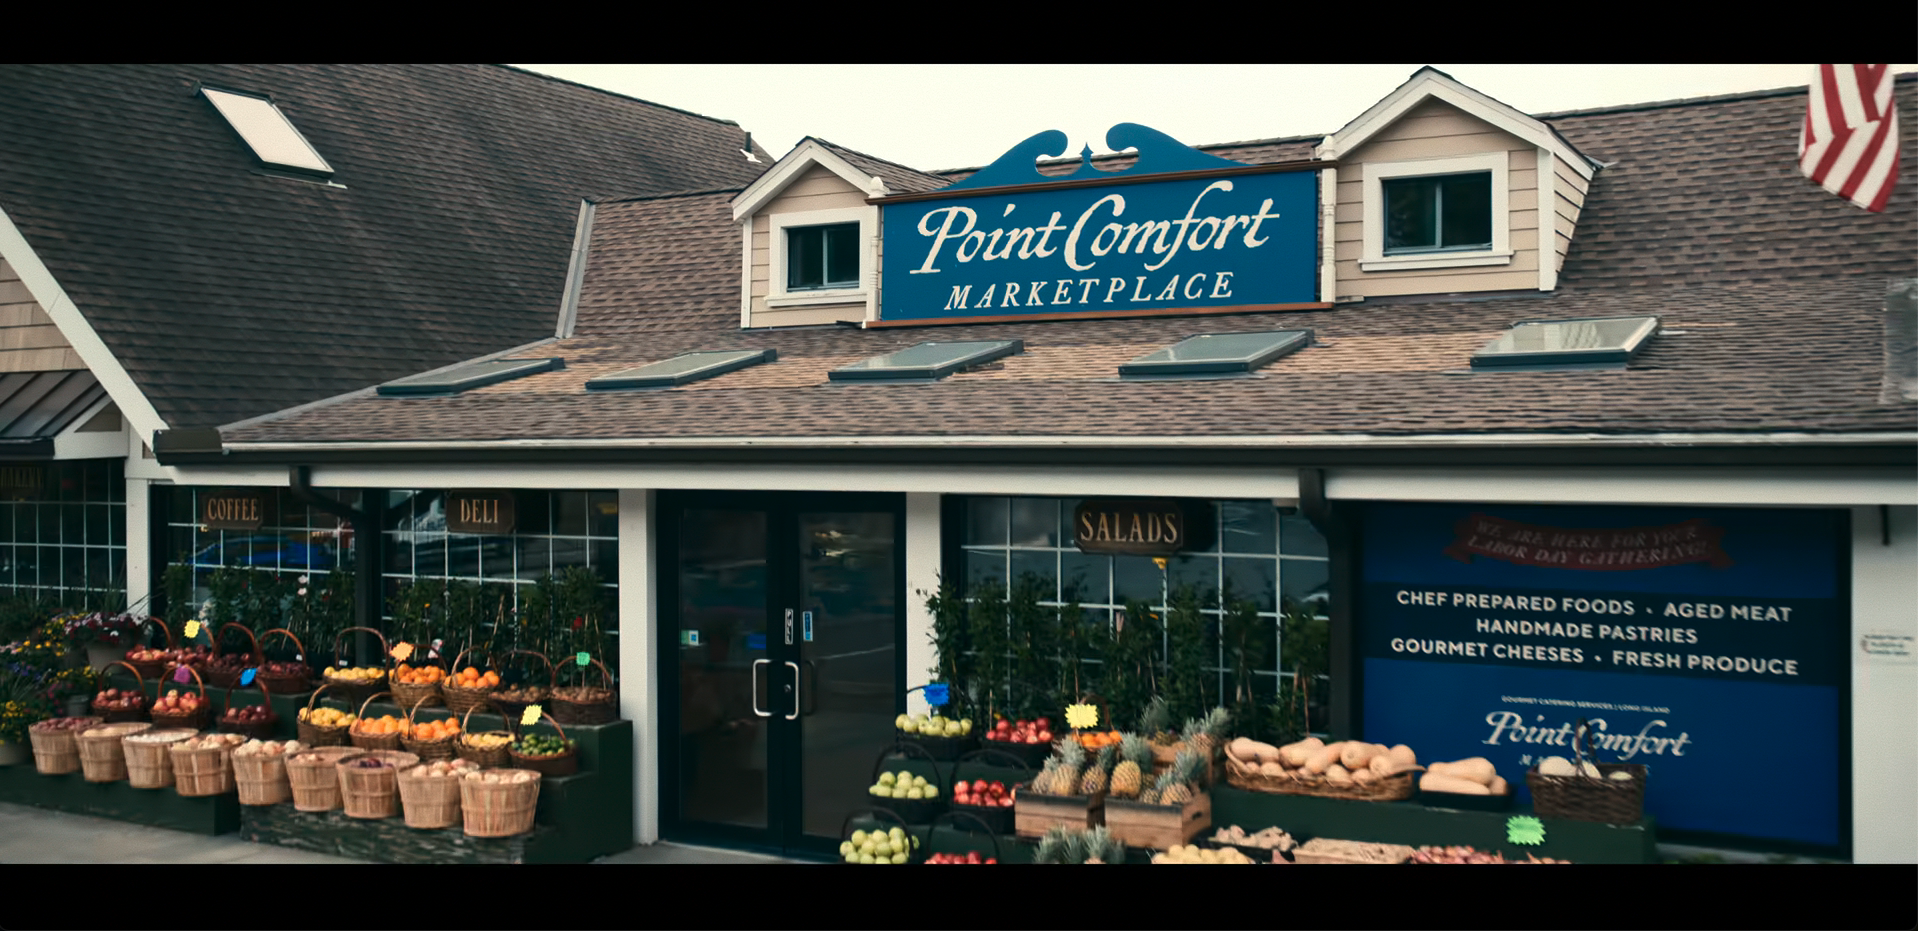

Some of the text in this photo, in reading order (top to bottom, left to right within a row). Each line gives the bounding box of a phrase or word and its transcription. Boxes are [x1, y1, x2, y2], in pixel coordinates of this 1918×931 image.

[910, 180, 1281, 275] Point Comfort
[944, 271, 1235, 311] MARKETPLACE
[207, 498, 259, 520] COFFEE
[460, 499, 499, 523] DELI
[1080, 511, 1178, 544] SALADS
[1477, 520, 1503, 537] WE
[1508, 530, 1543, 545] ARE
[1551, 533, 1602, 548] HERE
[1610, 532, 1645, 548] FOR
[1467, 535, 1528, 559] LABOR
[1534, 547, 1572, 564] DAY
[1397, 590, 1792, 622] CHEF PREPARED FOODS AGED MEAT
[1476, 618, 1698, 644] HANDMADE PASTRIES
[1391, 637, 1799, 676] GOURMET CHEESES FRESH PRODUCE
[1482, 711, 1691, 761] Point Comfort
